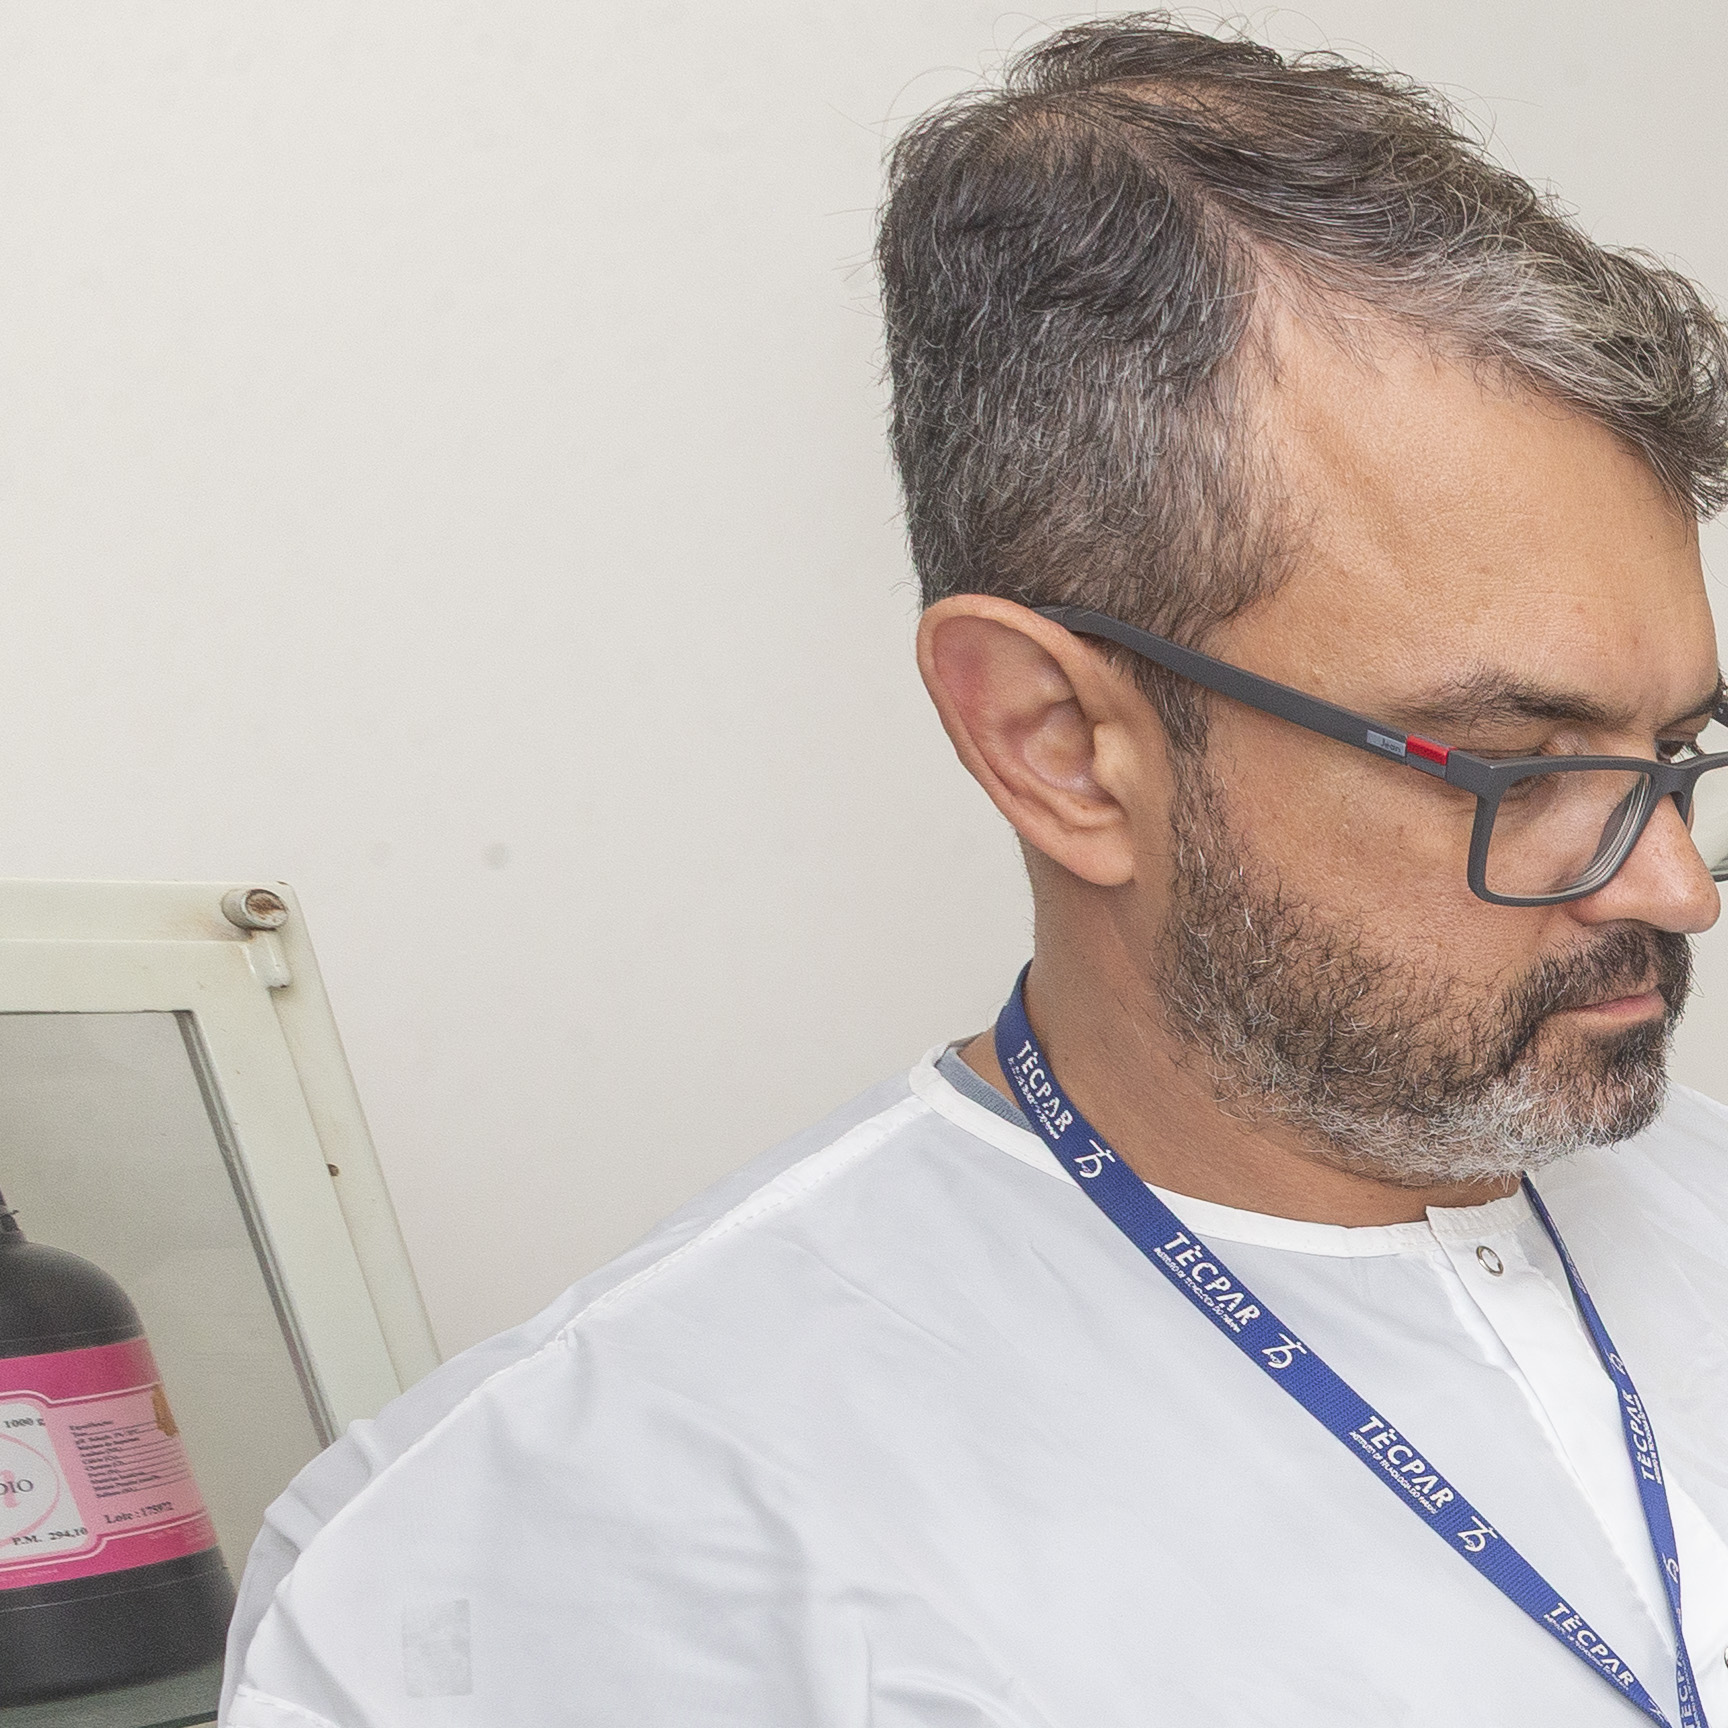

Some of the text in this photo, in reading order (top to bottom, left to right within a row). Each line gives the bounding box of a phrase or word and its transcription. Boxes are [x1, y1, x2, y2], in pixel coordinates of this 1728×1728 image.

[1016, 1040, 1074, 1132] TECPAR
[1164, 1232, 1261, 1326] TECPAR
[4, 1418, 34, 1429] 1000
[1359, 1416, 1455, 1509] TECPAR
[12, 1535, 43, 1546] P.M.
[104, 1513, 133, 1524] Lote
[1550, 1602, 1635, 1687] TECPAR
